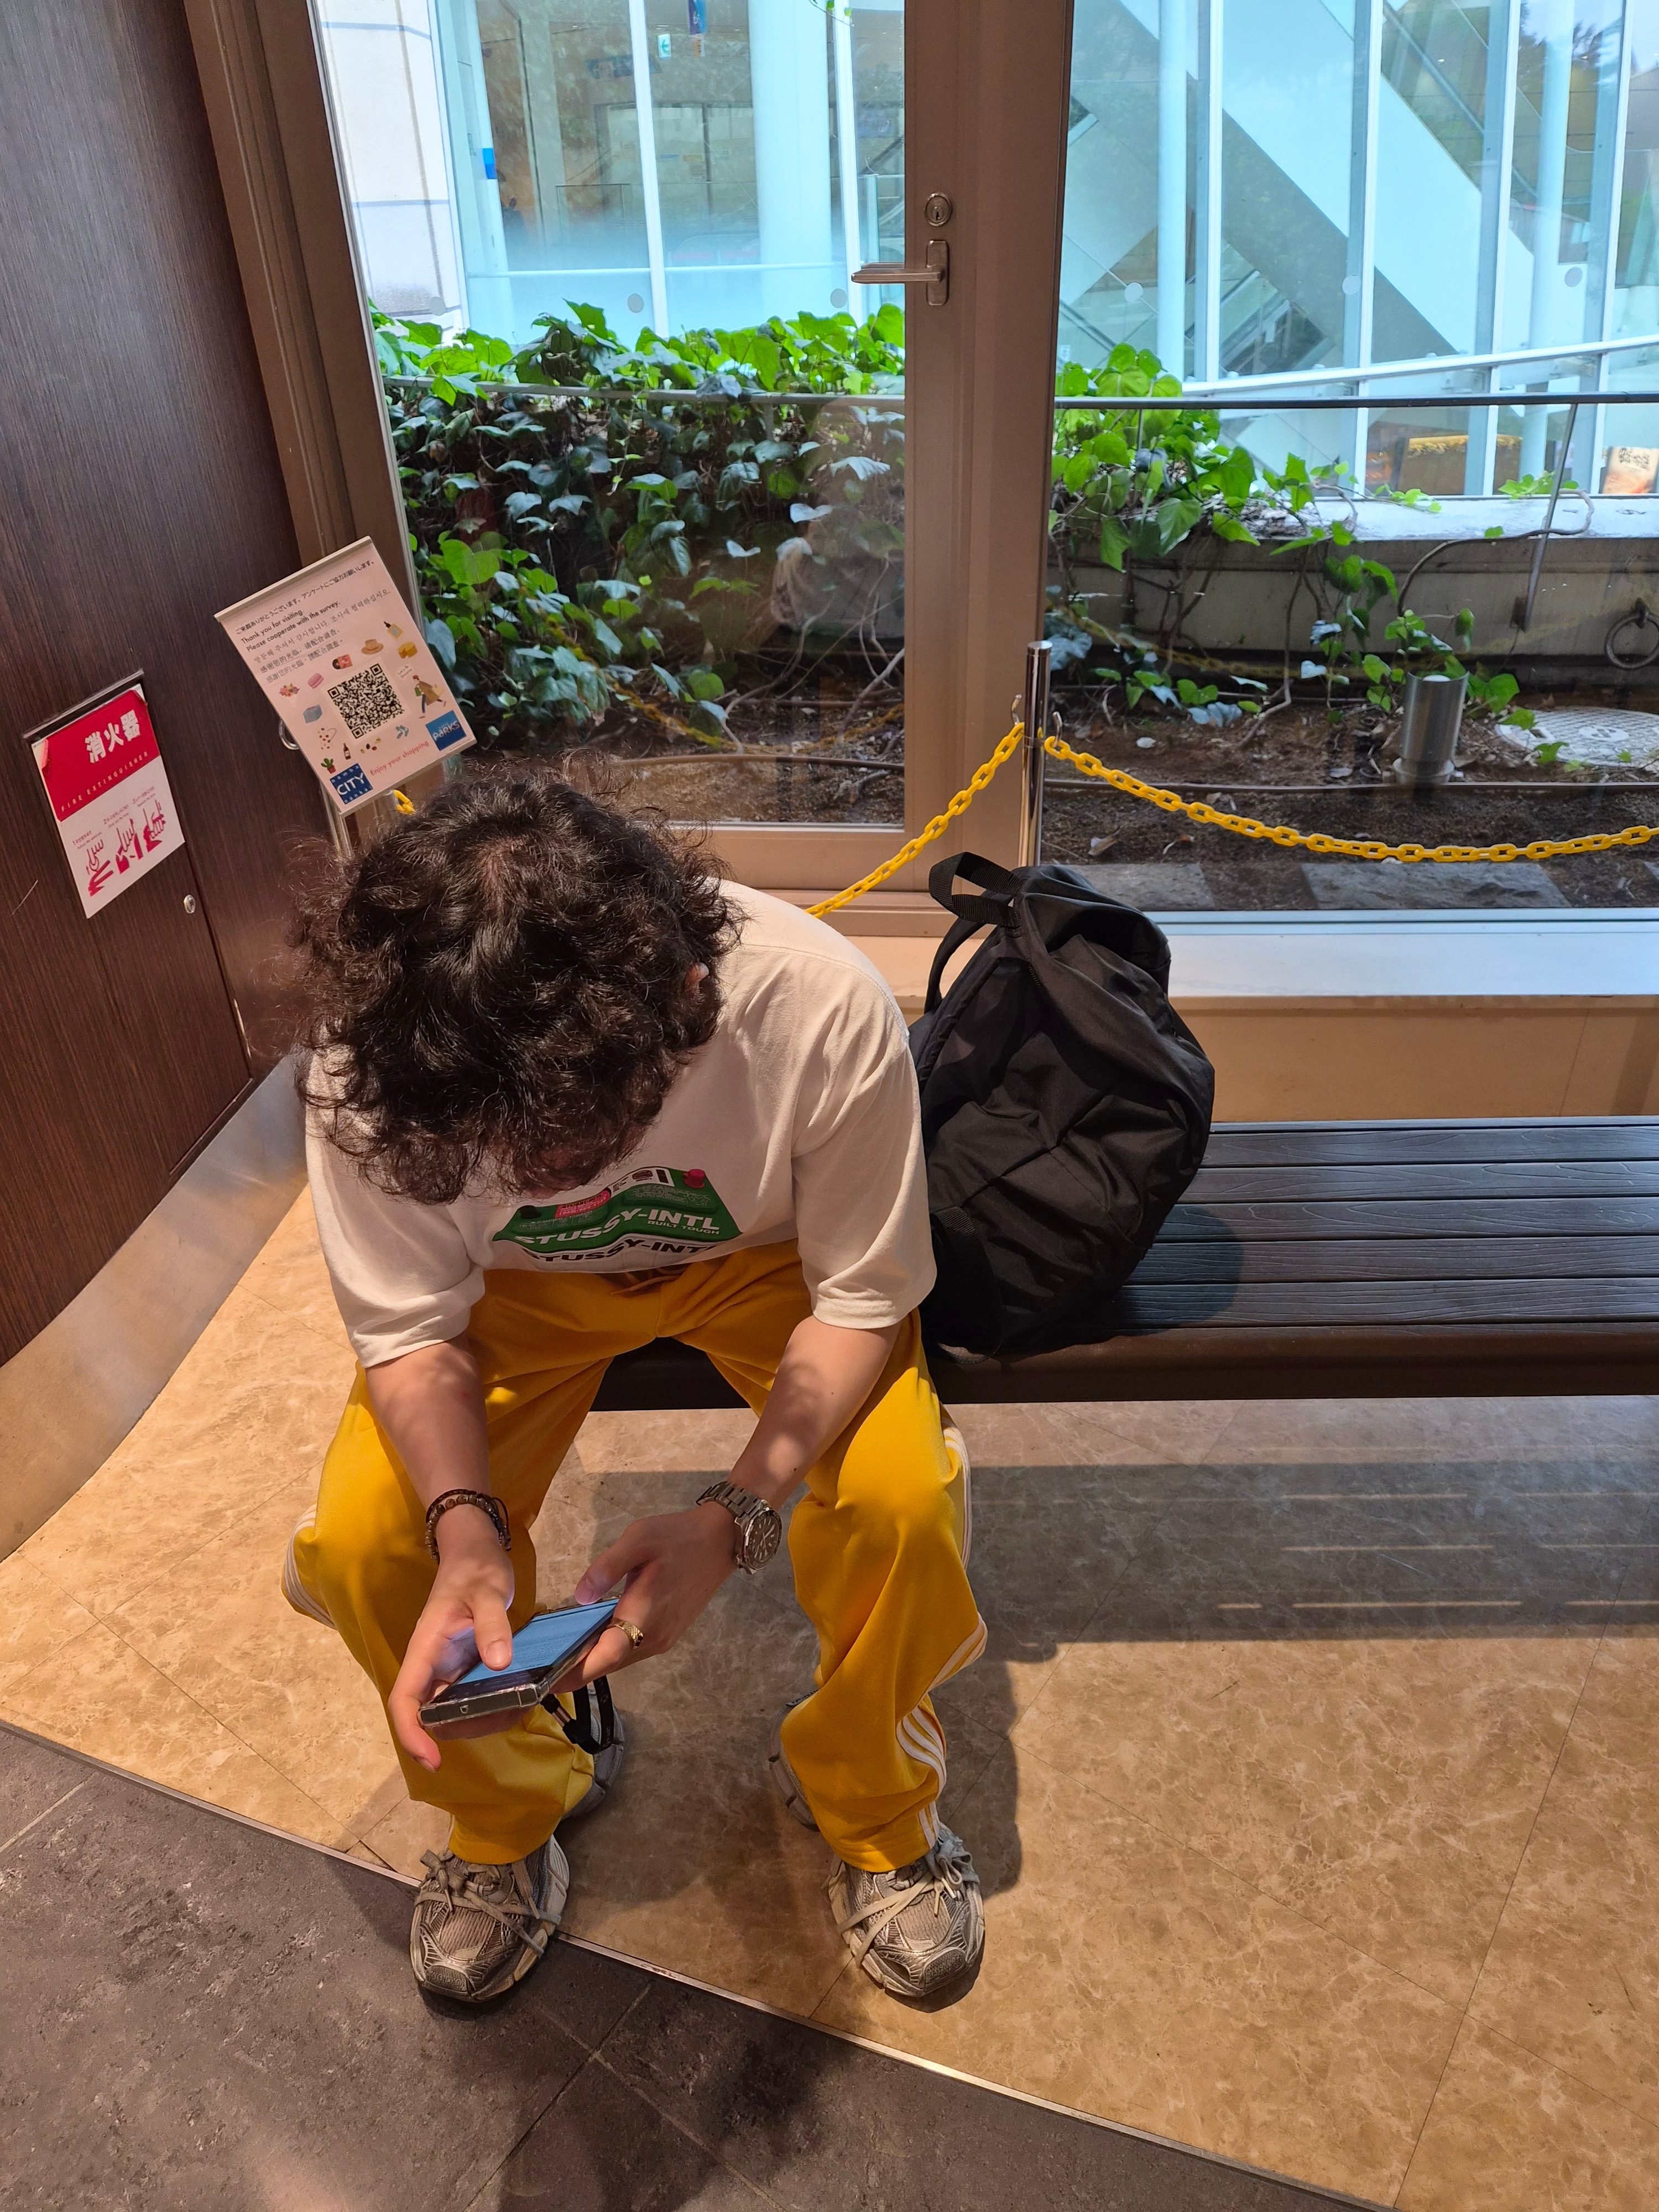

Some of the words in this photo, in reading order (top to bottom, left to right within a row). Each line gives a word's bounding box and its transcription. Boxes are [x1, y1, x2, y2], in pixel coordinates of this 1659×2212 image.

[240, 631, 260, 644] Thank
[260, 625, 272, 636] you
[271, 620, 281, 628] for
[281, 609, 304, 622] visiting.
[246, 639, 266, 652] Please
[267, 624, 296, 641] cooperate
[296, 615, 310, 625] with
[319, 601, 340, 613] survey.
[84, 708, 140, 763] 消火器
[332, 765, 359, 783] namba
[369, 764, 387, 775] Enjoy
[387, 755, 401, 767] your
[401, 740, 429, 758] shopping
[60, 794, 82, 812] FIRE
[86, 751, 148, 795] EXTINGUISHER
[337, 773, 364, 795] CITY
[345, 785, 372, 802] nankai
[514, 1208, 720, 1245] STUSSY-INTL
[681, 1225, 719, 1235] TOUGH
